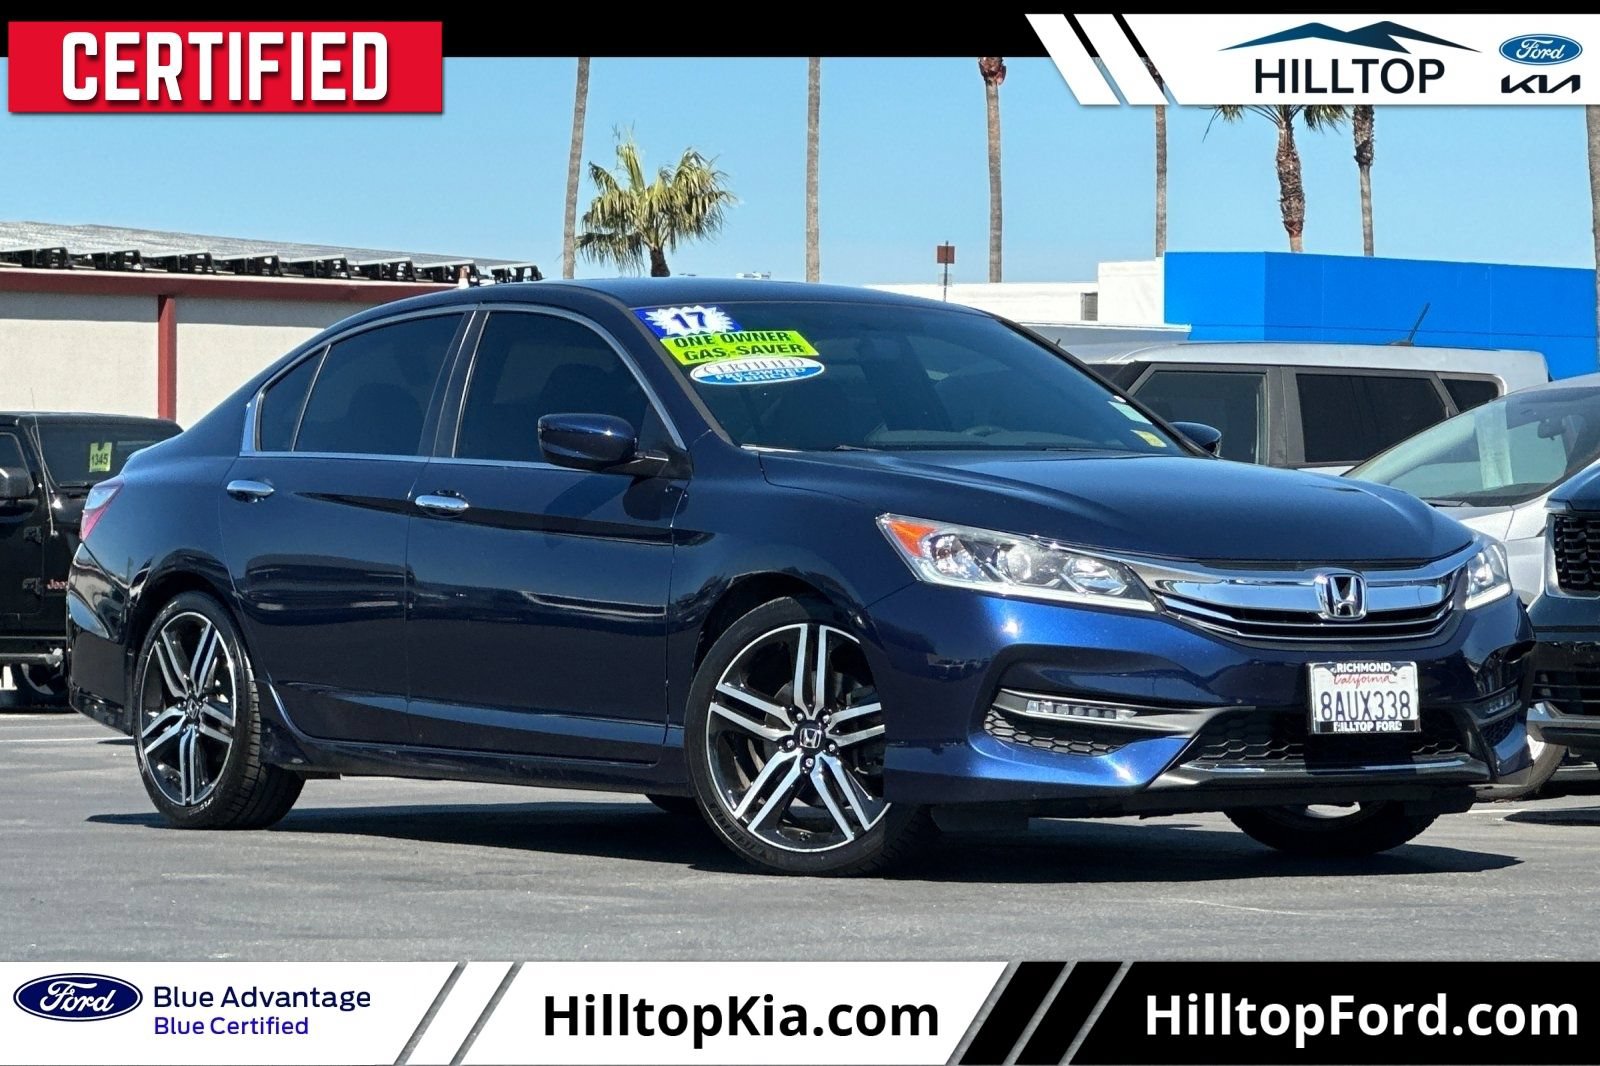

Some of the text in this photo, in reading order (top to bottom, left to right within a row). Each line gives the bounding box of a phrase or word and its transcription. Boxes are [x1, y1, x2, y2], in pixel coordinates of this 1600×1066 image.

[671, 311, 707, 329] 17
[674, 331, 791, 349] ONE OWNER
[1336, 662, 1392, 673] RICHMOND
[1333, 674, 1397, 689] California
[1320, 690, 1411, 721] 8AUX338
[1333, 721, 1402, 732] HILLTOP FORD
